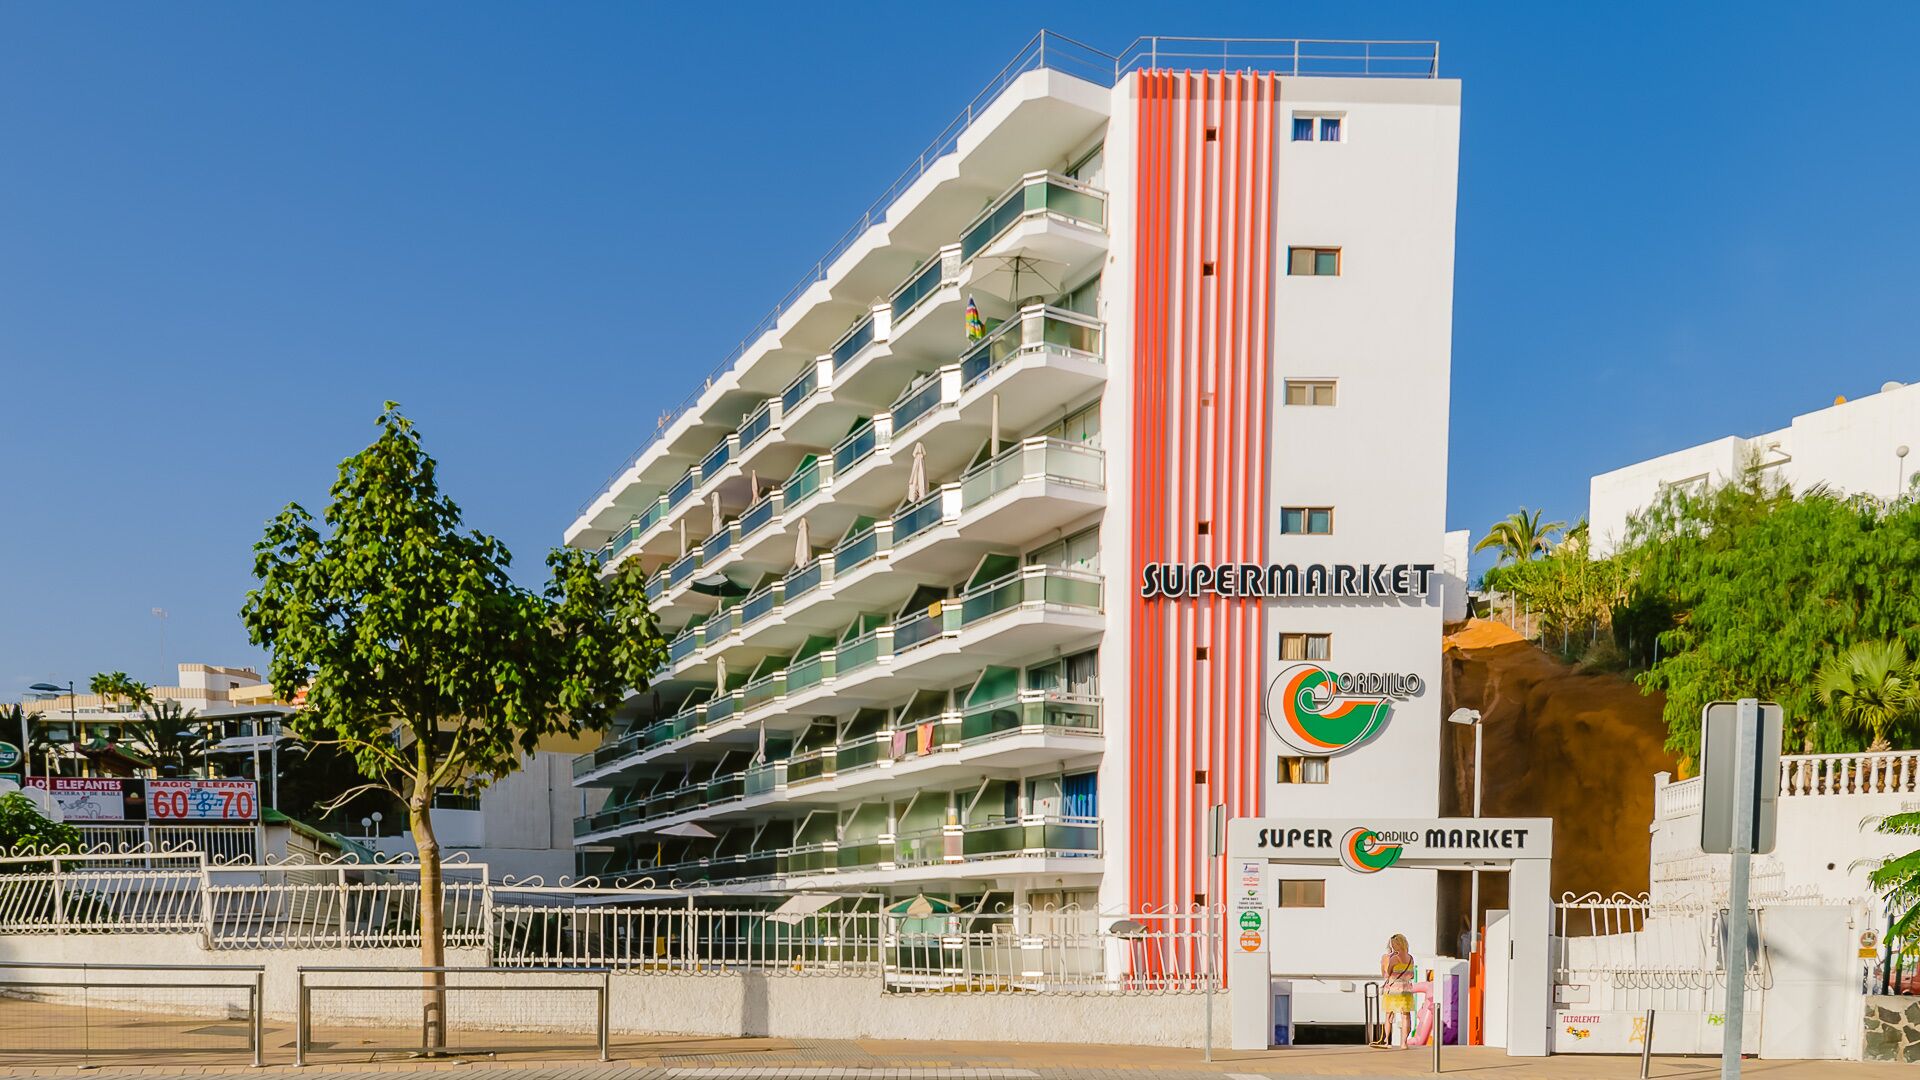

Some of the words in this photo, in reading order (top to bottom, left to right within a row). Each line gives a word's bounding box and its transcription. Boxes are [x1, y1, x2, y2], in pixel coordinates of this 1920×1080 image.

[1141, 562, 1436, 598] SUPERMARKET
[56, 780, 121, 790] ELEFANTES
[1257, 828, 1333, 848] SUPER
[1425, 829, 1529, 849] MARKET
